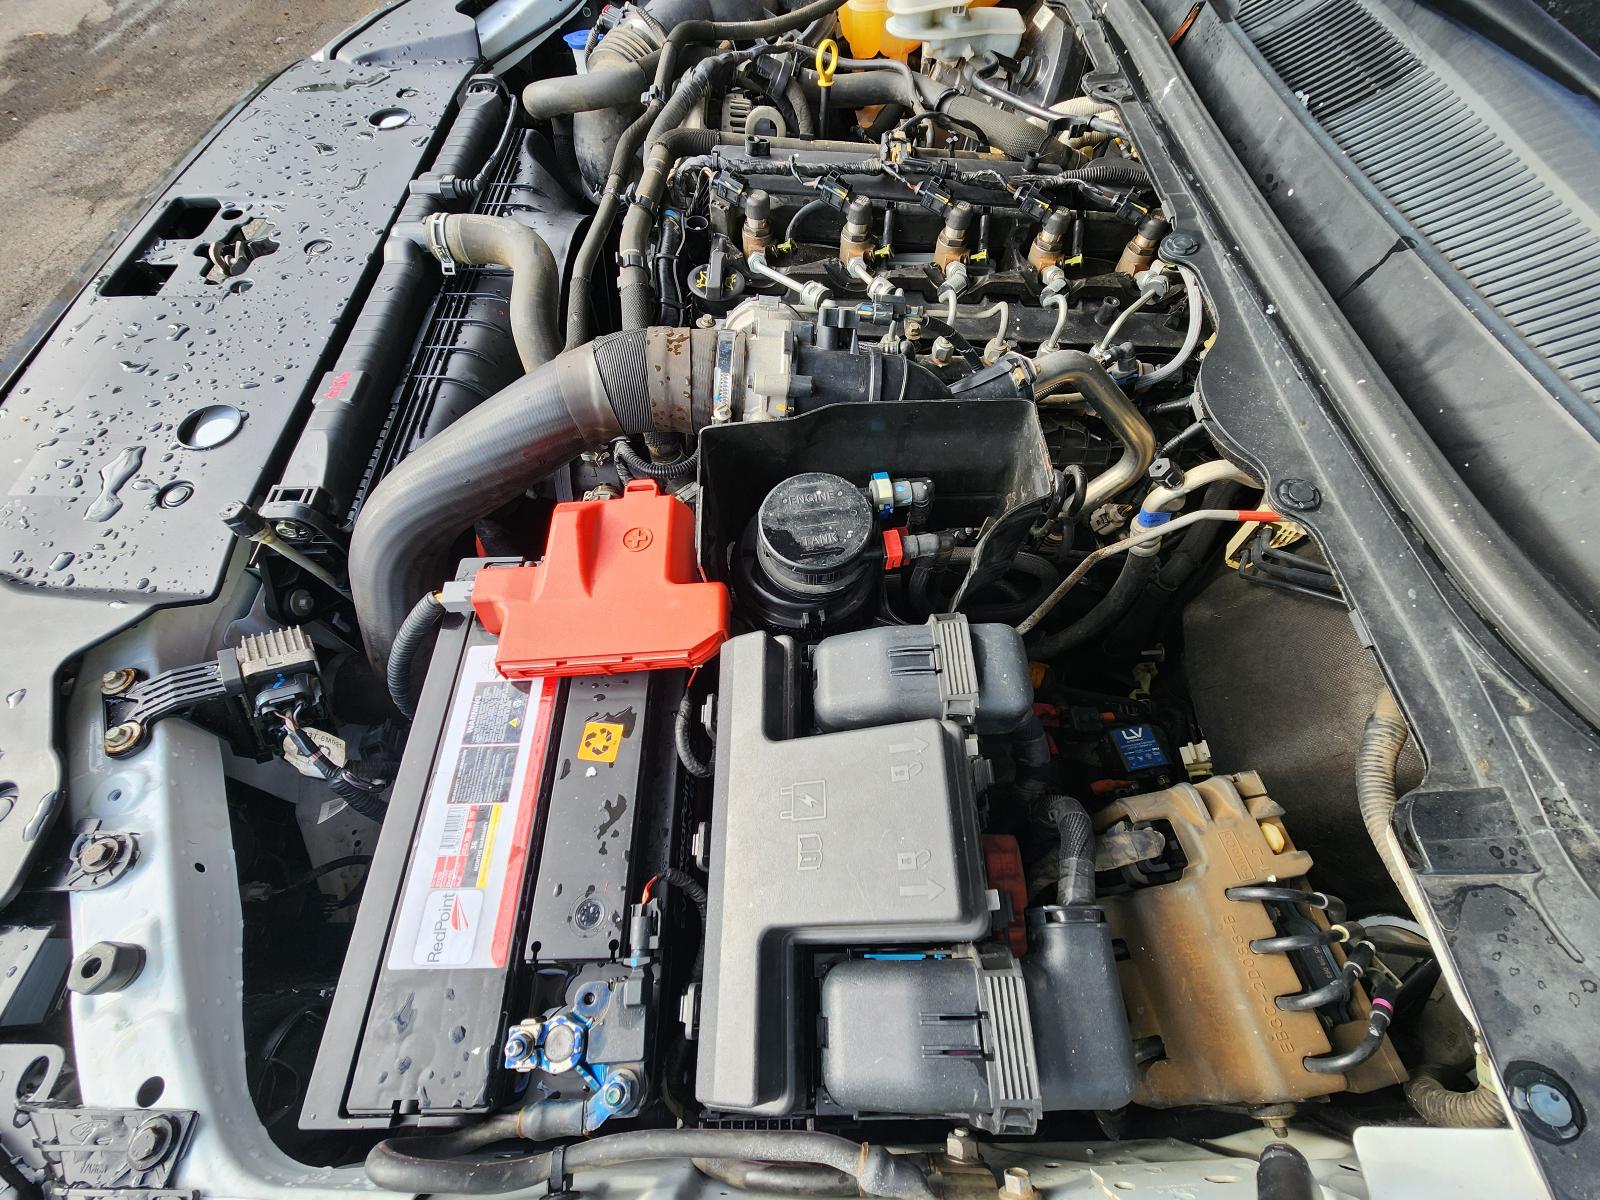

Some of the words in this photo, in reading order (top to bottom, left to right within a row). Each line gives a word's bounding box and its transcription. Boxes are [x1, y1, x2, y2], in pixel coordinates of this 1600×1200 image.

[788, 491, 836, 506] ENGINE
[801, 531, 840, 547] TANK
[465, 695, 483, 734] WARNING
[1121, 727, 1143, 740] LV
[473, 849, 483, 872] MONTHS
[427, 892, 456, 963] RedPoint
